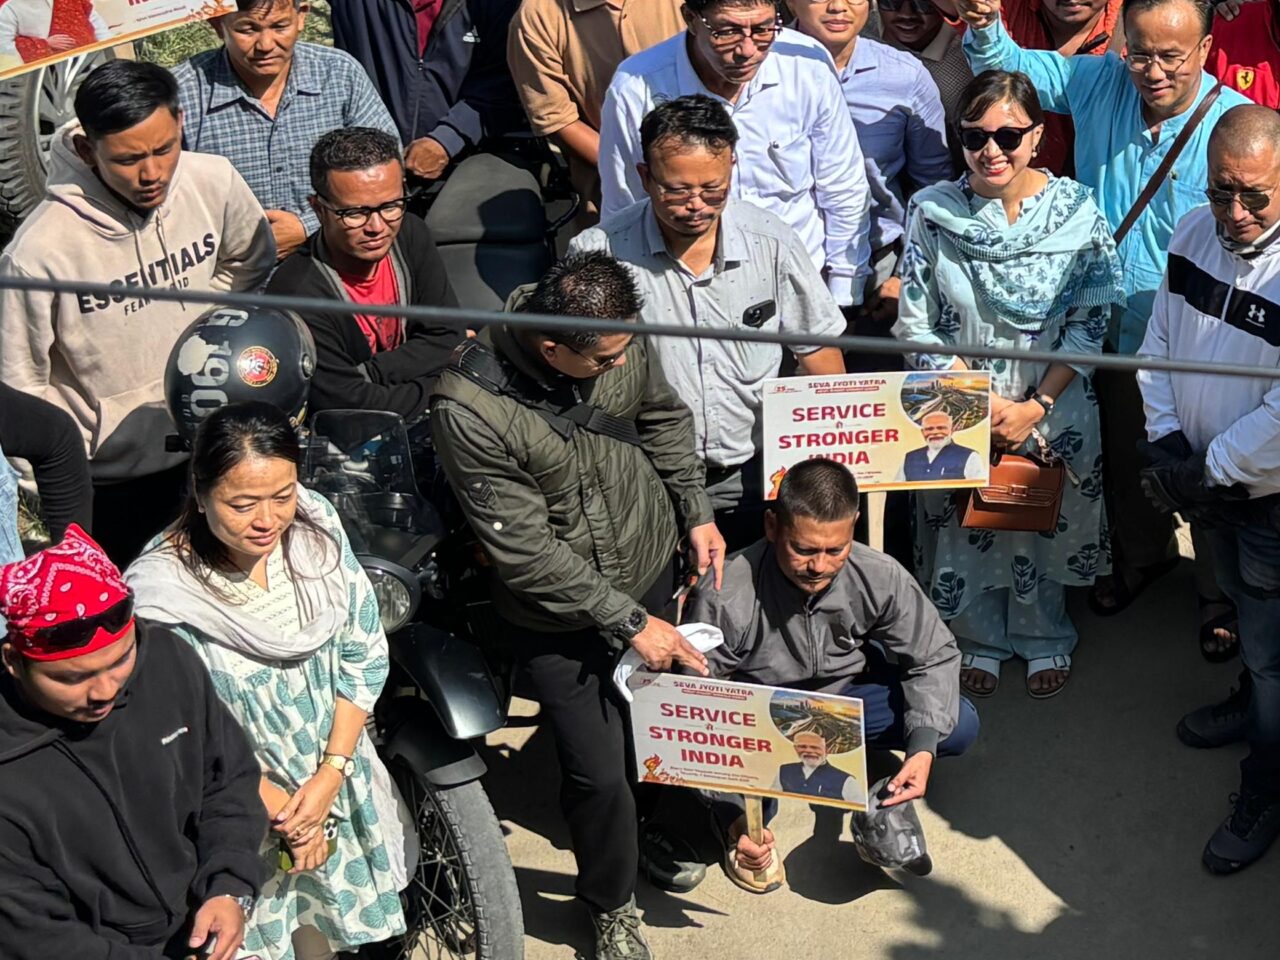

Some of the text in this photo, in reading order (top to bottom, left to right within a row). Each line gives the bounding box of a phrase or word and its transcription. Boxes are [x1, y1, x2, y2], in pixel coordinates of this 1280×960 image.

[792, 403, 886, 423] SERVICE
[778, 428, 899, 449] STRONGER
[699, 683, 723, 692] JYOTI
[725, 686, 754, 696] YATRA
[660, 703, 756, 726] SERVICE
[649, 726, 772, 753] STRONGER
[681, 749, 745, 768] INDIA
